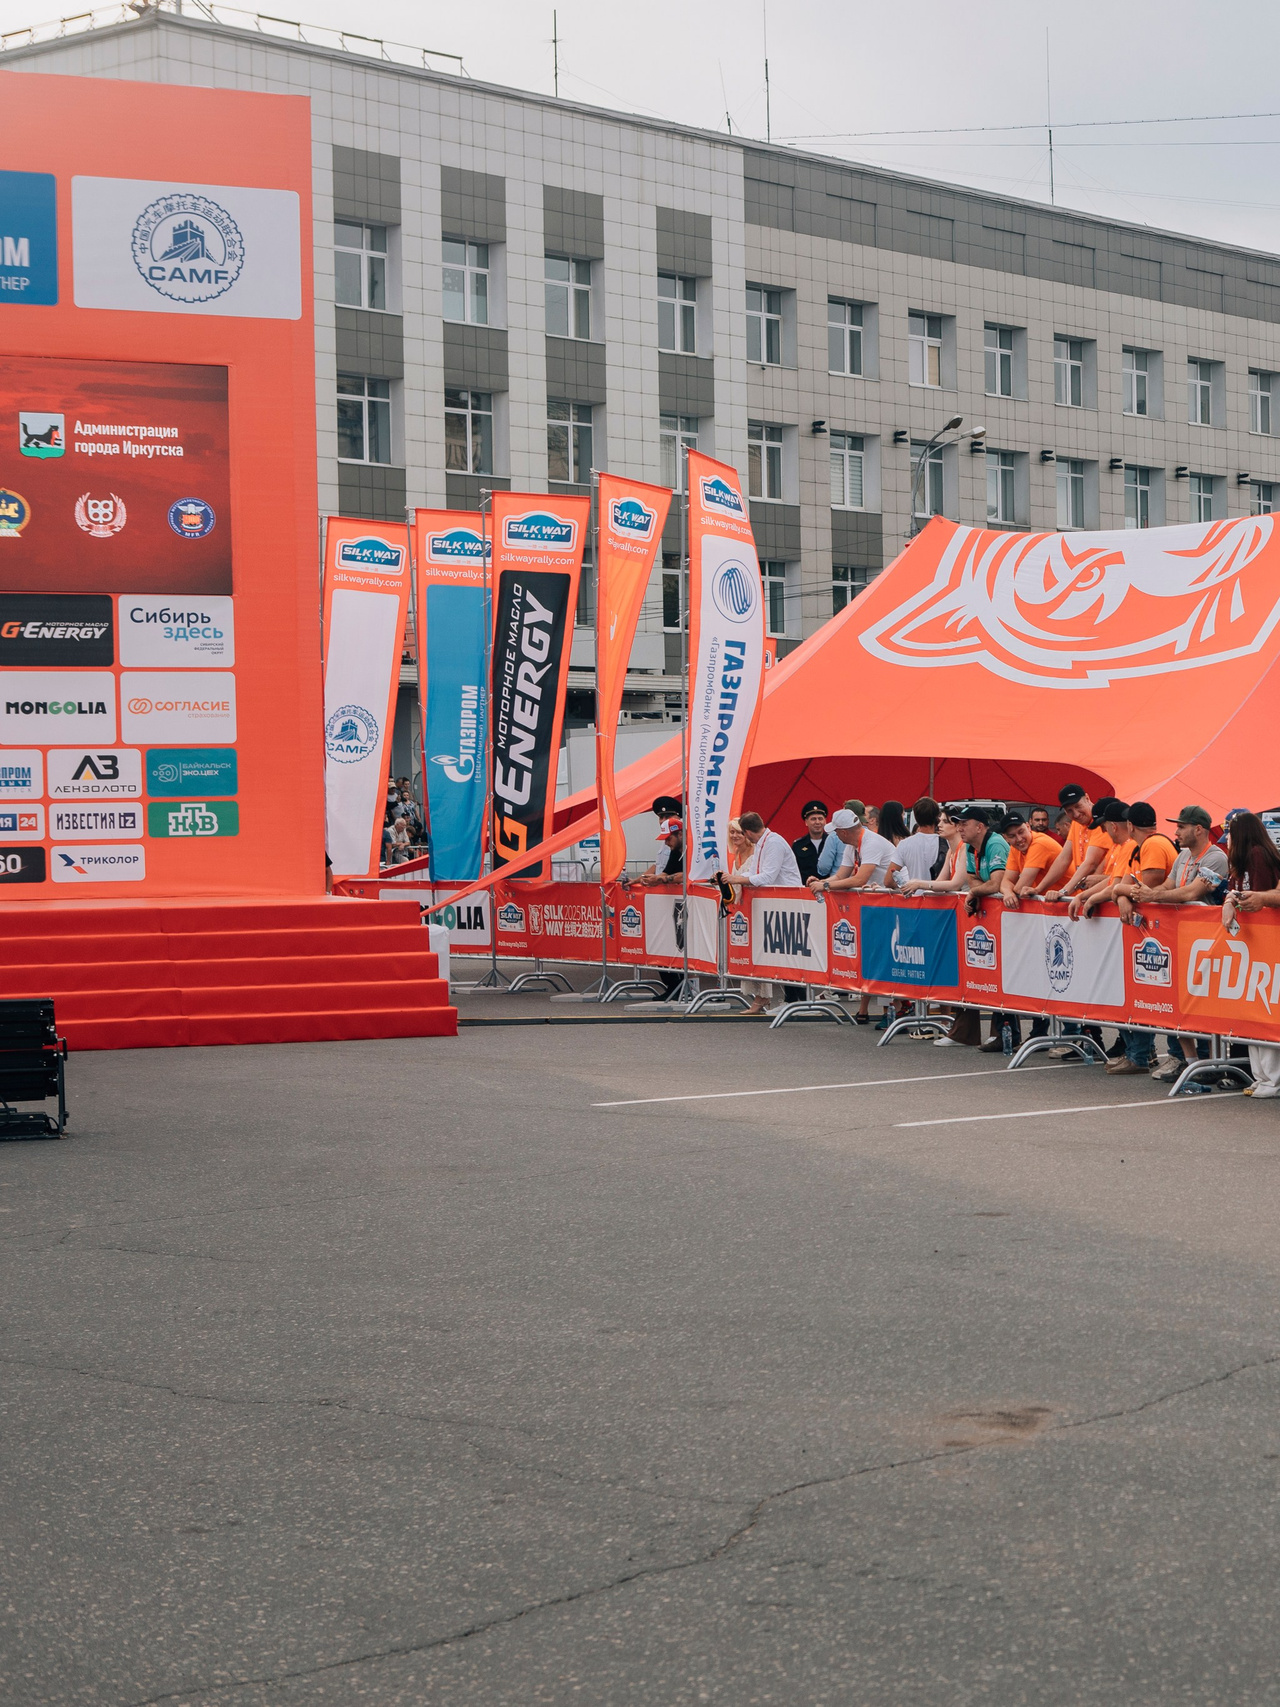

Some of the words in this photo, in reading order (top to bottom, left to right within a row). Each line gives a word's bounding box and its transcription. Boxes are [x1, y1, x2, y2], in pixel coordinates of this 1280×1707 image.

[0, 236, 29, 267] М
[148, 266, 229, 285] CAMF
[74, 420, 179, 438] Администрация
[74, 441, 120, 457] города
[122, 441, 184, 458] Иркутска
[704, 485, 725, 498] SILK
[724, 494, 740, 504] WAY
[631, 514, 651, 524] WAY
[509, 523, 539, 533] SILK
[541, 525, 571, 535] WAY
[433, 540, 461, 550] SILK
[343, 546, 371, 556] SILK
[373, 550, 400, 560] WAY
[356, 555, 385, 563] RALLY
[500, 553, 575, 566] silkwayrally.com
[333, 573, 403, 587] silkwayrally.com
[130, 607, 212, 628] Сибирь
[163, 626, 224, 642] здесь
[497, 648, 516, 749] МОТОРНОЕ
[507, 583, 523, 645] МАСЛО
[6, 701, 107, 715] MONGOLIA
[155, 701, 230, 712] СОГЛАСИЕ
[459, 685, 478, 754] ГАЗПРОМ
[327, 743, 369, 755] CAMF
[701, 639, 747, 860] ГАЗПРОМБАНК
[0, 766, 31, 779] ПРОМ
[54, 785, 137, 793] ЛЕНЗОЛОТО
[20, 816, 36, 828] 24
[56, 812, 115, 830] ИЗВЕСТИЯ
[120, 813, 135, 828] iz
[168, 803, 218, 836] НТВ
[80, 856, 139, 865] ТРИКОЛОР
[544, 904, 563, 920] SILK
[563, 905, 581, 921] 2025
[545, 922, 564, 936] WAY
[763, 911, 811, 957] KAMAZ
[968, 940, 981, 949] SILK
[981, 941, 993, 951] WAY
[1137, 953, 1152, 963] SILK
[1153, 955, 1168, 965] WAY
[891, 967, 907, 978] GENERAL
[907, 968, 926, 979] PARTNER
[1050, 970, 1070, 981] CAMF
[1134, 999, 1173, 1013] #silkwayrally2025
